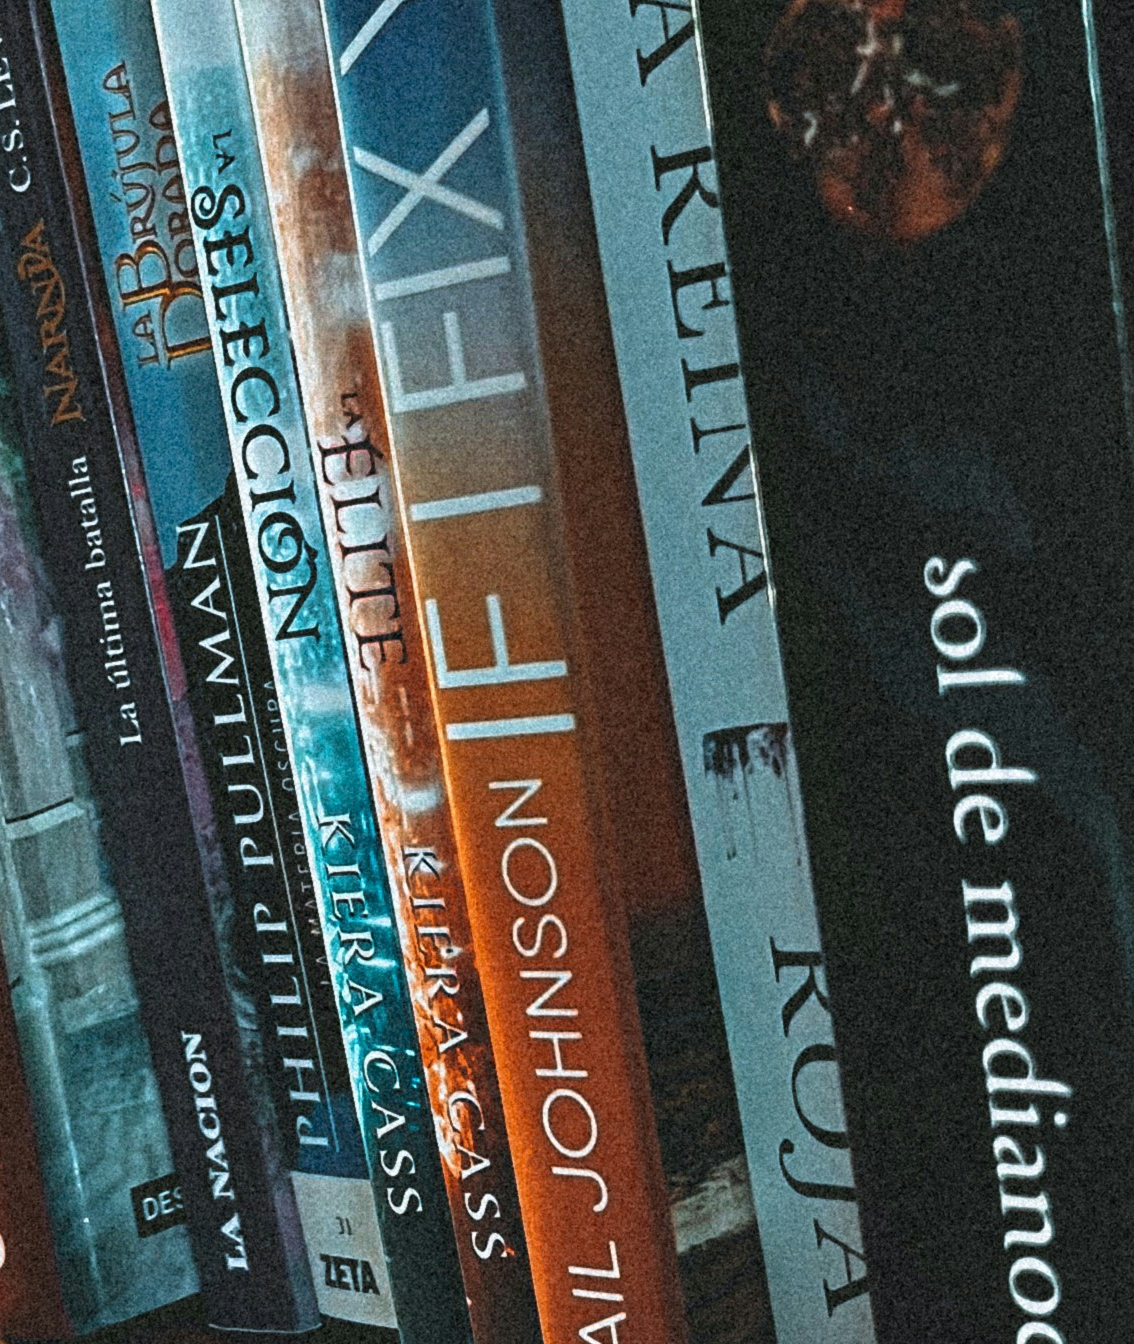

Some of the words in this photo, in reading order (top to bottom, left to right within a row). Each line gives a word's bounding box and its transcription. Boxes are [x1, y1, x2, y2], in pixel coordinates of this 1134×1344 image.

[209, 128, 239, 174] LA
[17, 219, 86, 425] NARNIA
[353, 107, 529, 414] FIX
[126, 318, 162, 368] LA
[190, 182, 321, 642] SELECCIÓN
[650, 142, 768, 626] REINA
[67, 455, 106, 570] batalla
[409, 484, 544, 523] I
[96, 580, 131, 690] última
[176, 519, 275, 869] PULLMAN
[425, 593, 577, 741] IF
[922, 554, 1027, 696] sol
[119, 702, 143, 746] La
[943, 728, 1039, 846] de
[254, 904, 329, 1149] PHILIP
[317, 816, 387, 1015] KIERA
[363, 1049, 423, 1216] CASS
[402, 846, 469, 1056] KIERA
[447, 1083, 507, 1261] CASS
[488, 777, 609, 1214] JOHNSON
[180, 1029, 236, 1201] NACION
[220, 1212, 250, 1272] LA
